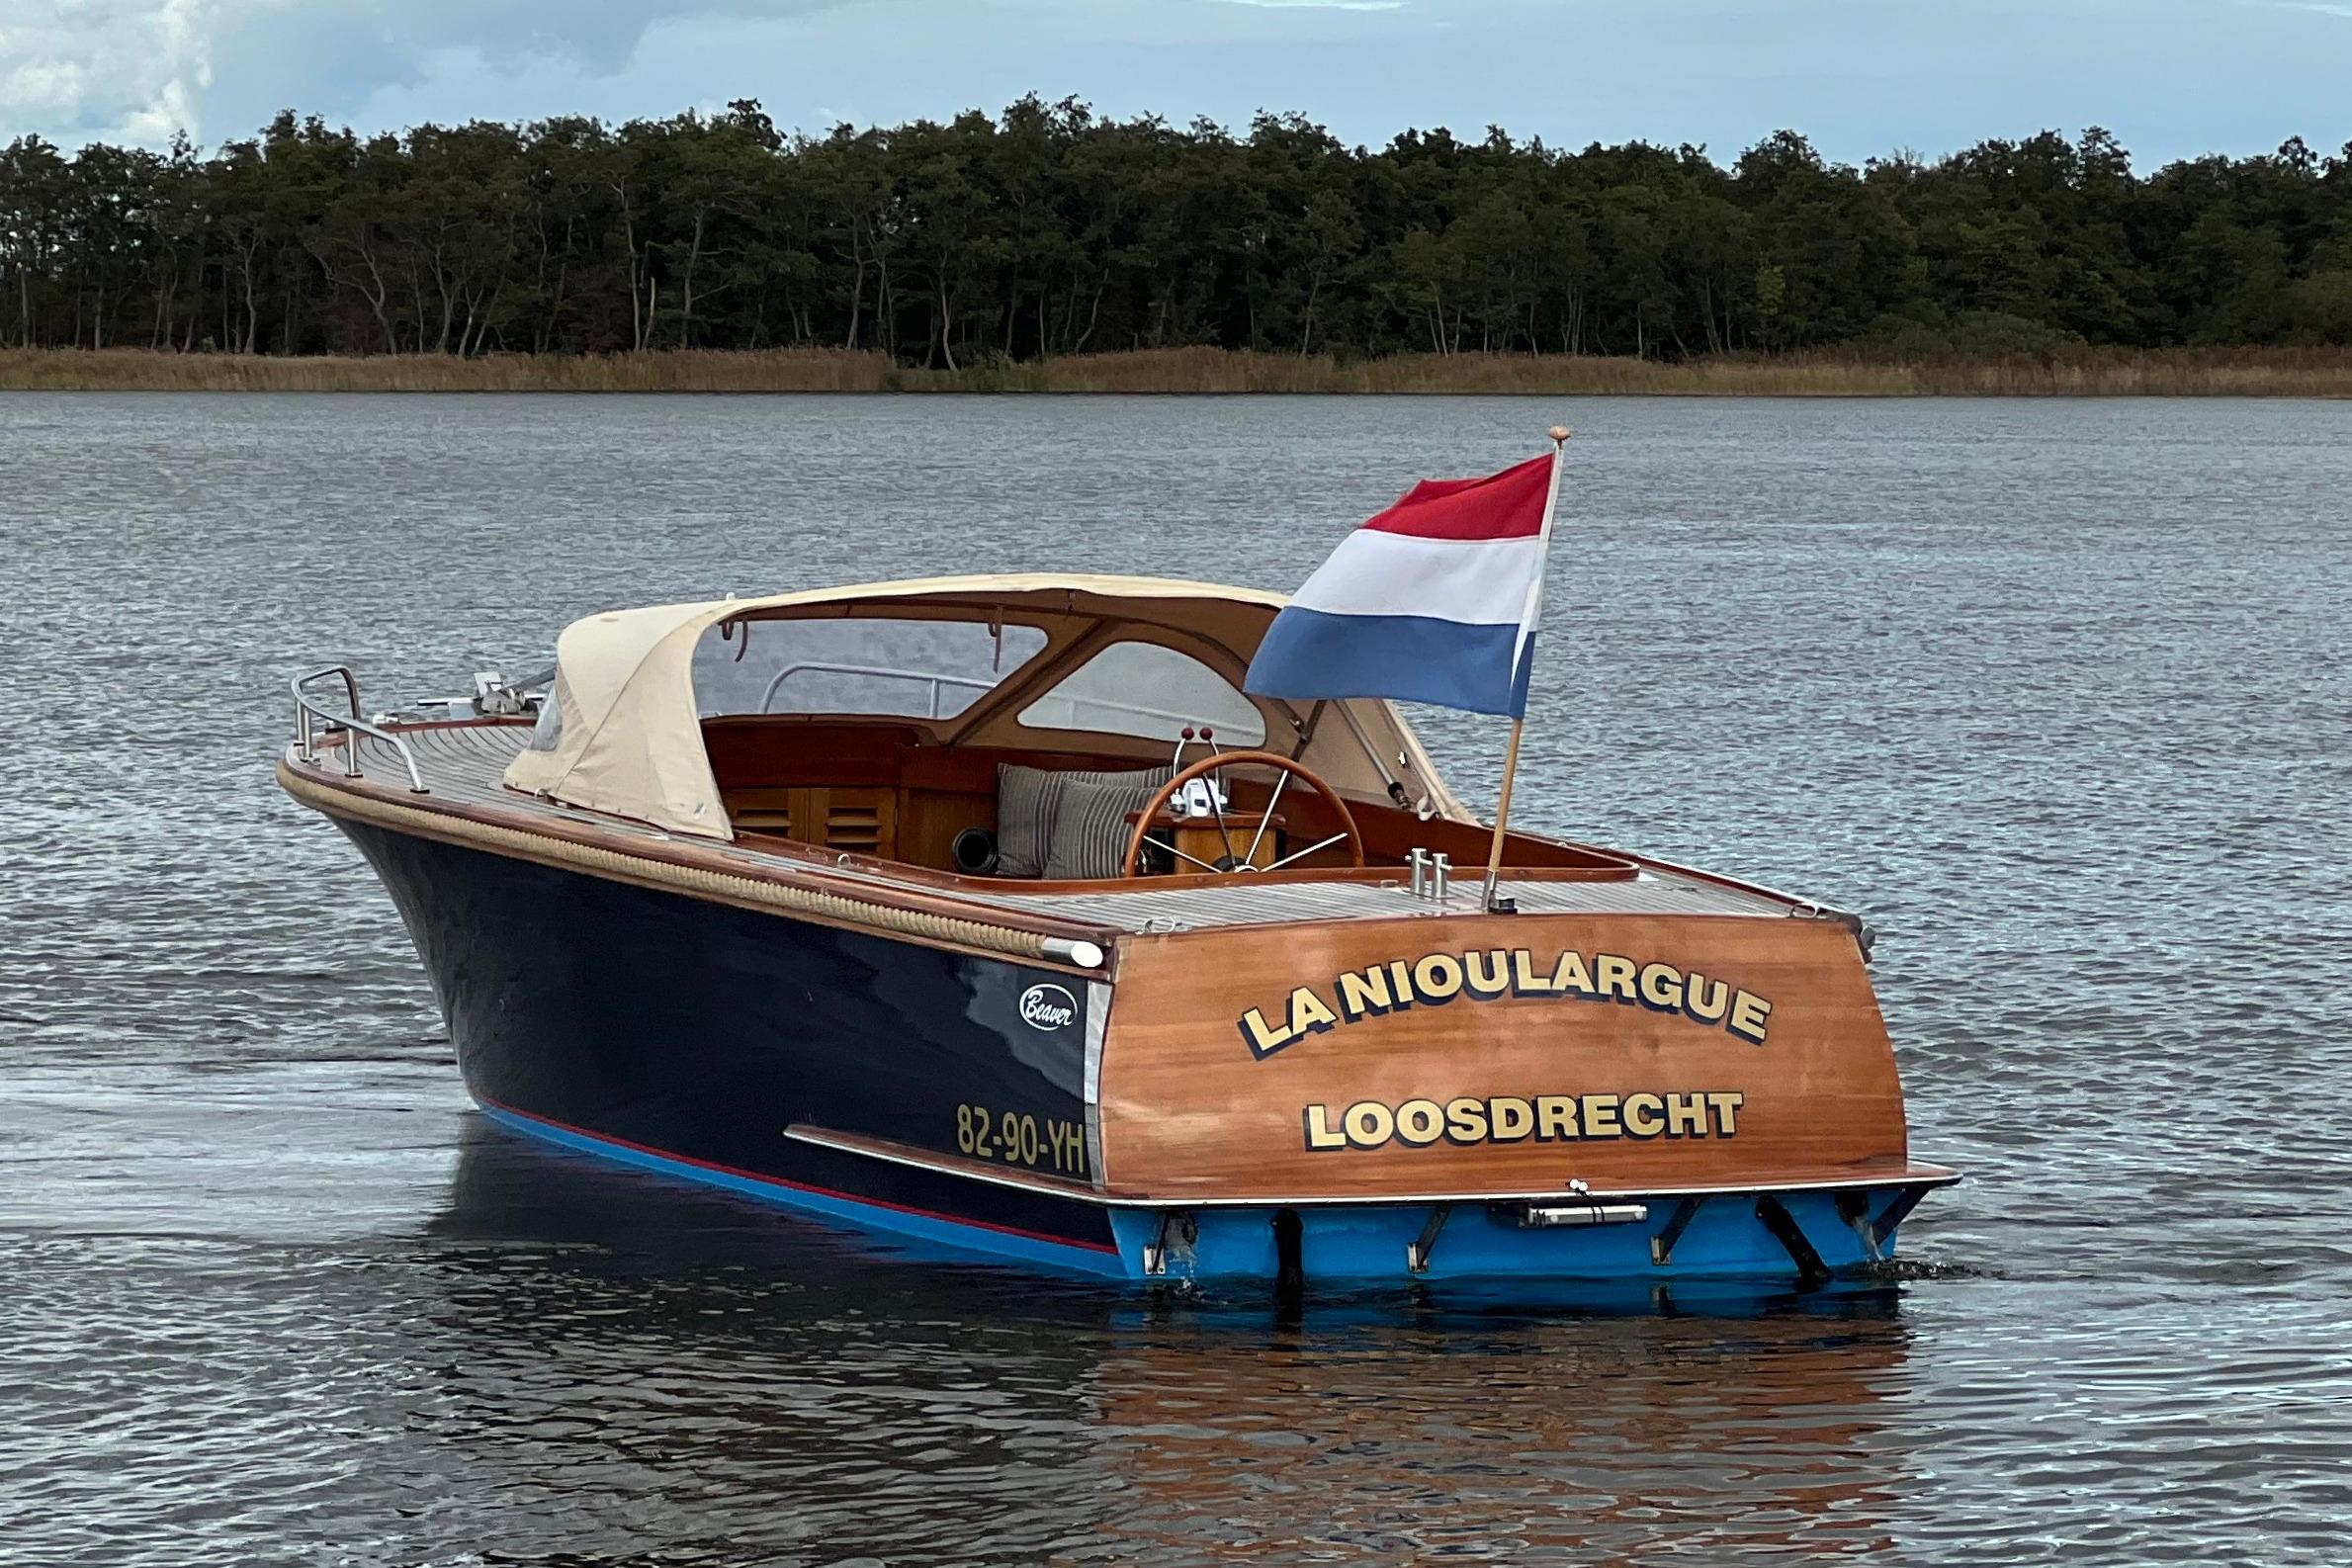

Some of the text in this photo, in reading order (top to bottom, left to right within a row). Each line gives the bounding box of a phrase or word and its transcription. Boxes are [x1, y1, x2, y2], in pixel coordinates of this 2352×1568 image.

[1024, 989, 1074, 1026] Beaver
[1240, 949, 1773, 1059] LA NIOULARGUE
[956, 1102, 1085, 1174] 82-90-YH
[1306, 1091, 1745, 1150] LOOSDRECHT
